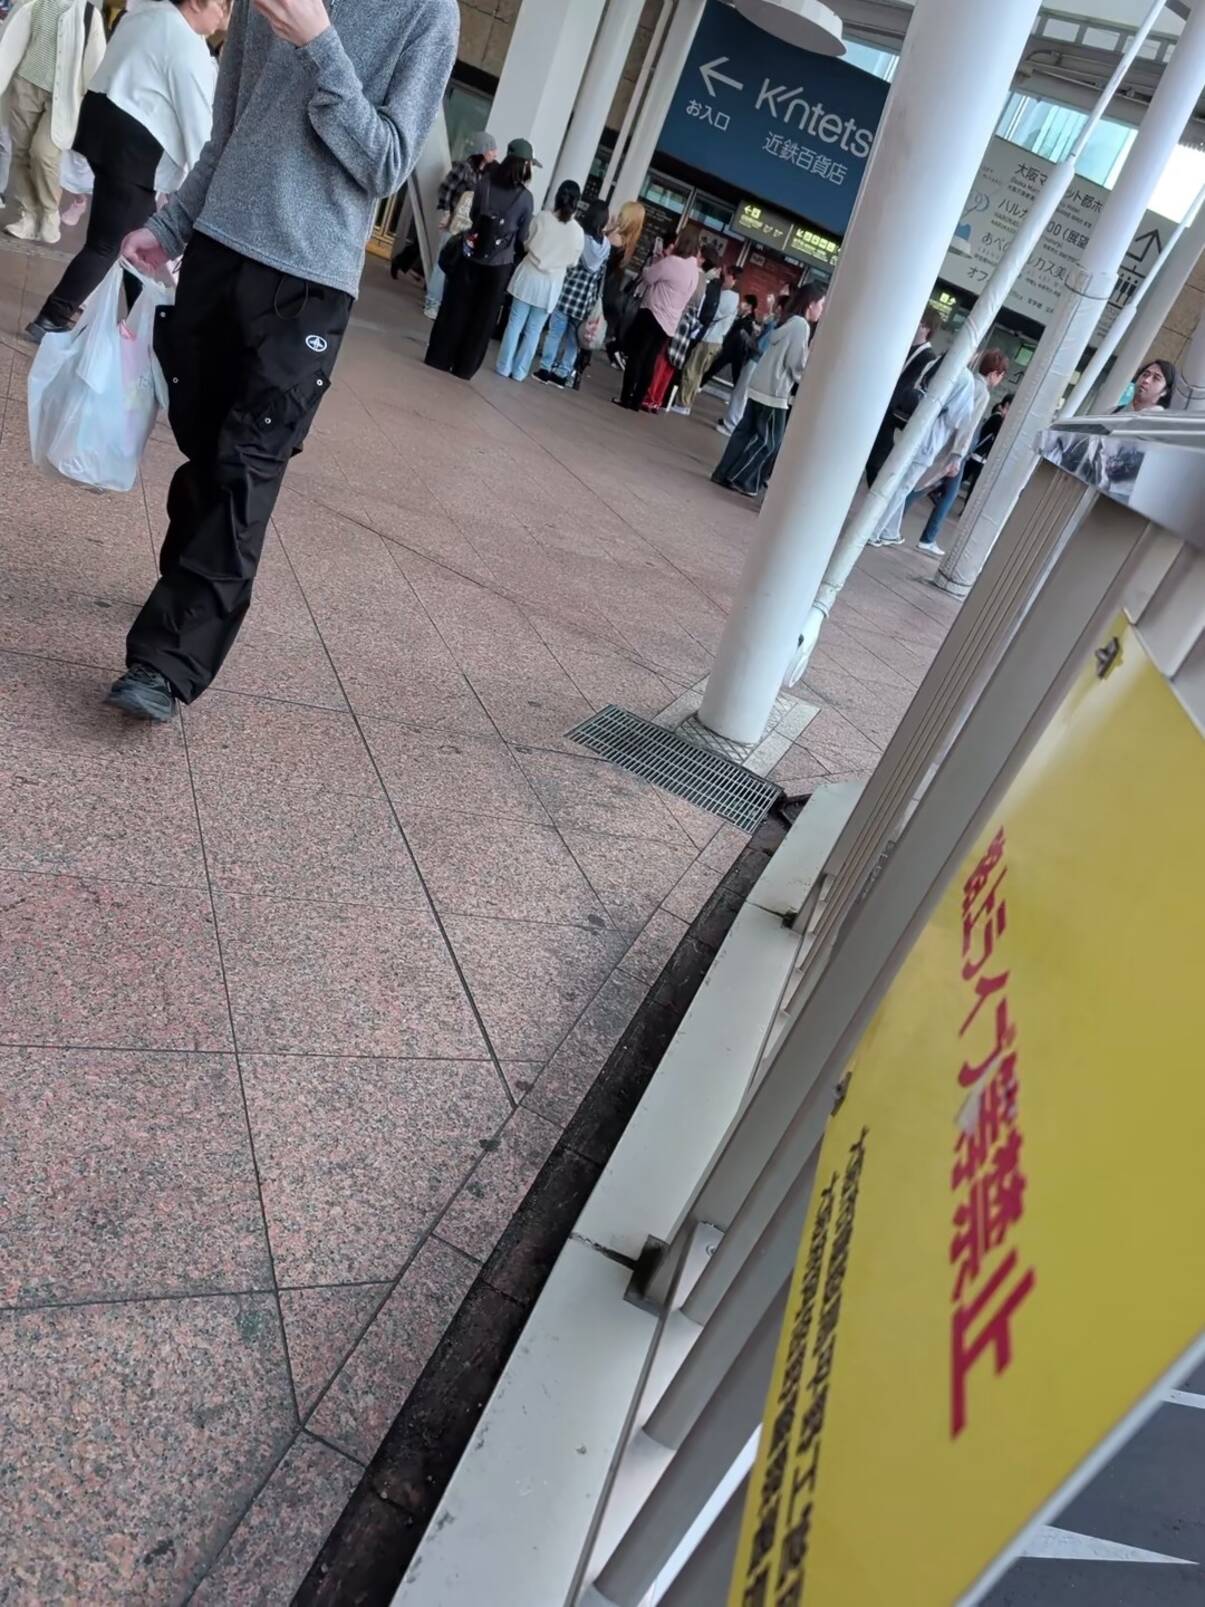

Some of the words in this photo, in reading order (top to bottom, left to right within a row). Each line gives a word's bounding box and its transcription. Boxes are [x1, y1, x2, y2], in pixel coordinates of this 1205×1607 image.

[685, 98, 731, 131] お入口
[754, 77, 874, 159] Kintets
[762, 130, 848, 186] 近鉄百貨店
[950, 826, 1037, 1440] 路上ライブ等禁止
